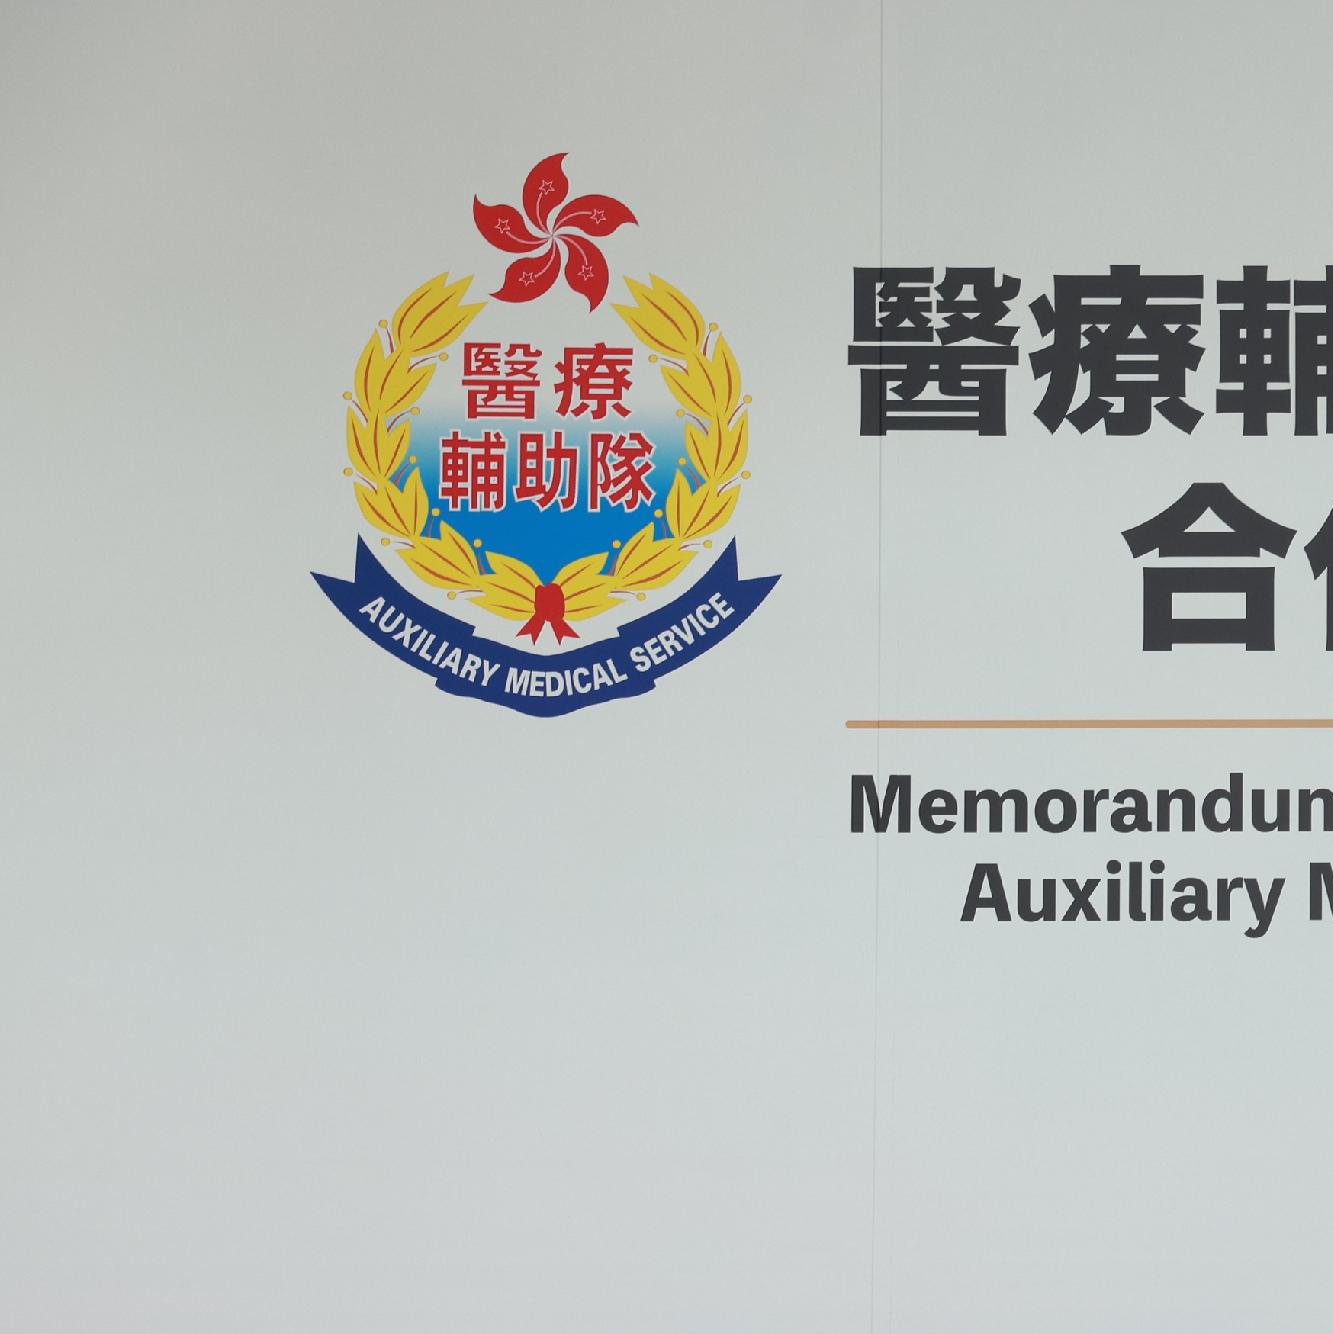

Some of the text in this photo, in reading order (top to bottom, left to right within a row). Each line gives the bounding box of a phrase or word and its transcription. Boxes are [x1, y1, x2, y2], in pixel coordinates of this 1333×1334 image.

[462, 342, 636, 420] 醫療
[440, 431, 656, 510] 輔助隊
[359, 592, 736, 697] AUXILIARY MEDICAL SERVICE
[961, 859, 1286, 939] Auxiliary
